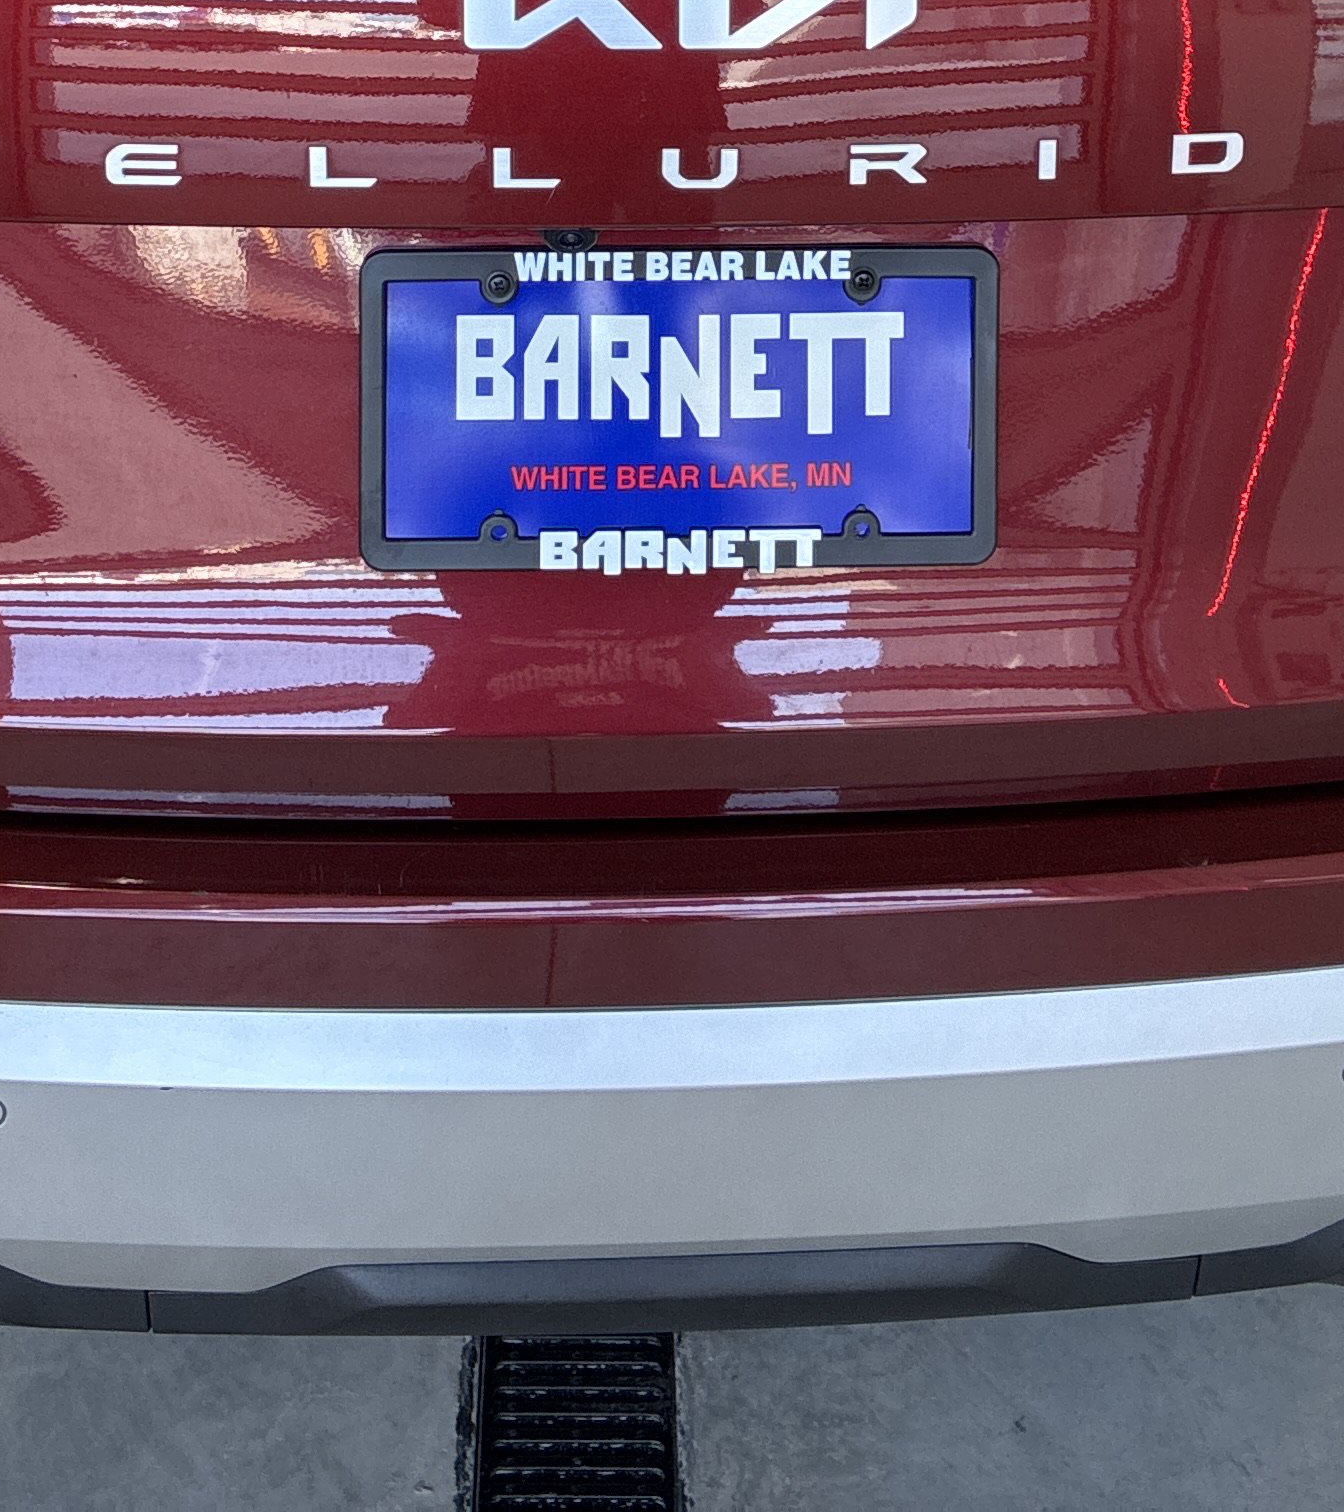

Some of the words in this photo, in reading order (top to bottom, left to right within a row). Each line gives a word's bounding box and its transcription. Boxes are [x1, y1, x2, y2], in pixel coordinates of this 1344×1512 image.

[513, 251, 635, 282] WHITE
[645, 251, 745, 281] BEAR
[755, 250, 852, 281] LAKE
[455, 311, 905, 438] BARNETT
[511, 466, 608, 492] WHITE
[616, 465, 701, 490] BEAR
[709, 463, 798, 492] LAKE,
[807, 462, 852, 487] MN
[539, 528, 822, 576] BARNETT
